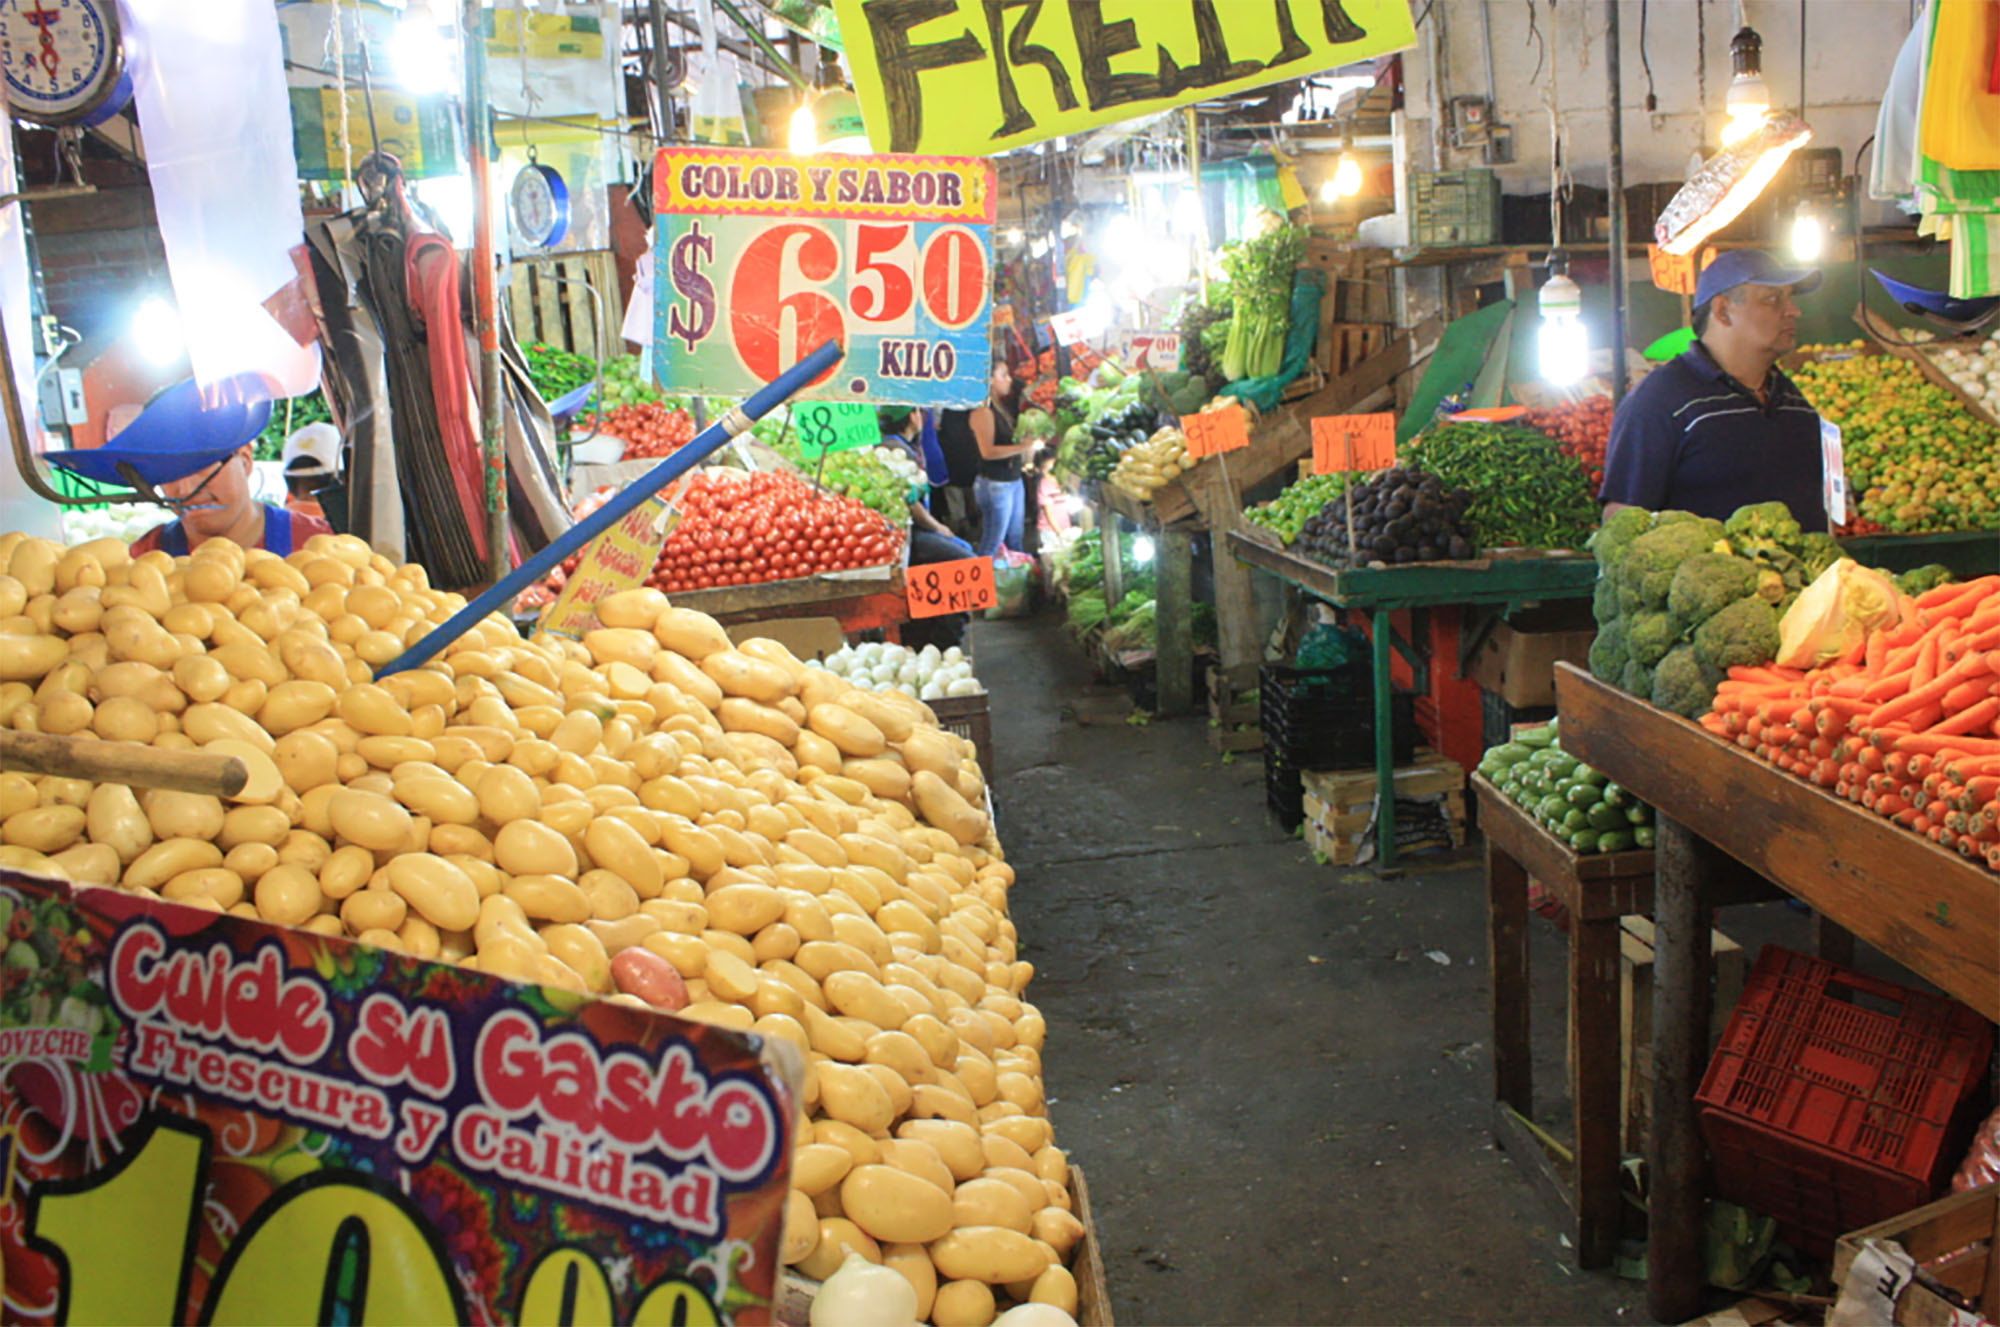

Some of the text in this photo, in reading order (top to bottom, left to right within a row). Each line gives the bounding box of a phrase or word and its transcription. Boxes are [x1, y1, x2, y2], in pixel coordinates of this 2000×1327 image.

[682, 164, 798, 202] COLOR
[808, 167, 832, 201] Y
[838, 169, 961, 206] SABOR
[880, 341, 954, 379] KILO
[949, 588, 988, 610] KILO
[111, 924, 333, 1064] Cuide
[475, 1011, 774, 1182] Gasto
[131, 1023, 393, 1131] Frescura
[453, 1105, 719, 1236] Calidad
